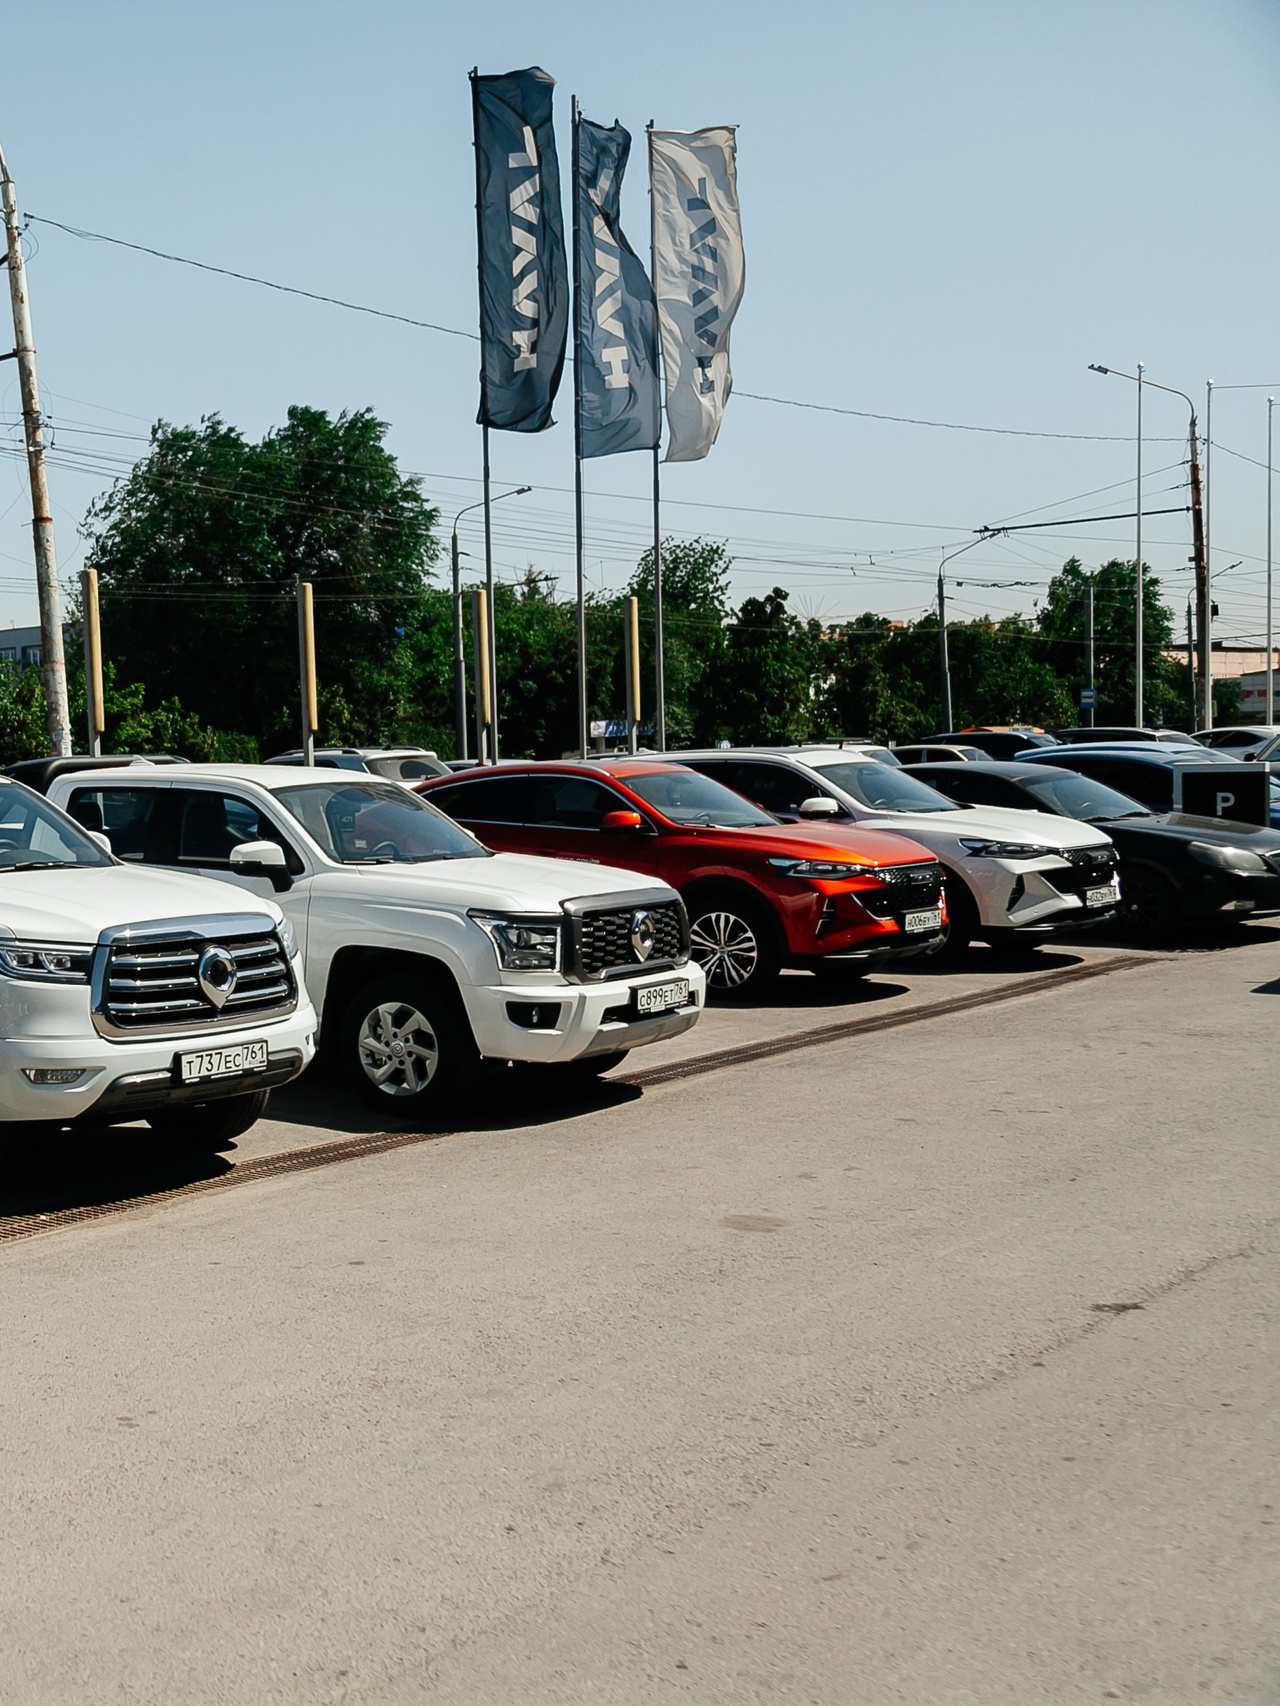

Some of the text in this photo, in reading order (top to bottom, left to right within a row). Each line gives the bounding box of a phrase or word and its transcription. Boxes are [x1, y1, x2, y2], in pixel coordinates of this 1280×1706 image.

[508, 125, 540, 373] HAVAL
[685, 177, 720, 395] HAVAL
[1216, 792, 1235, 816] P
[243, 1044, 265, 1061] 761
